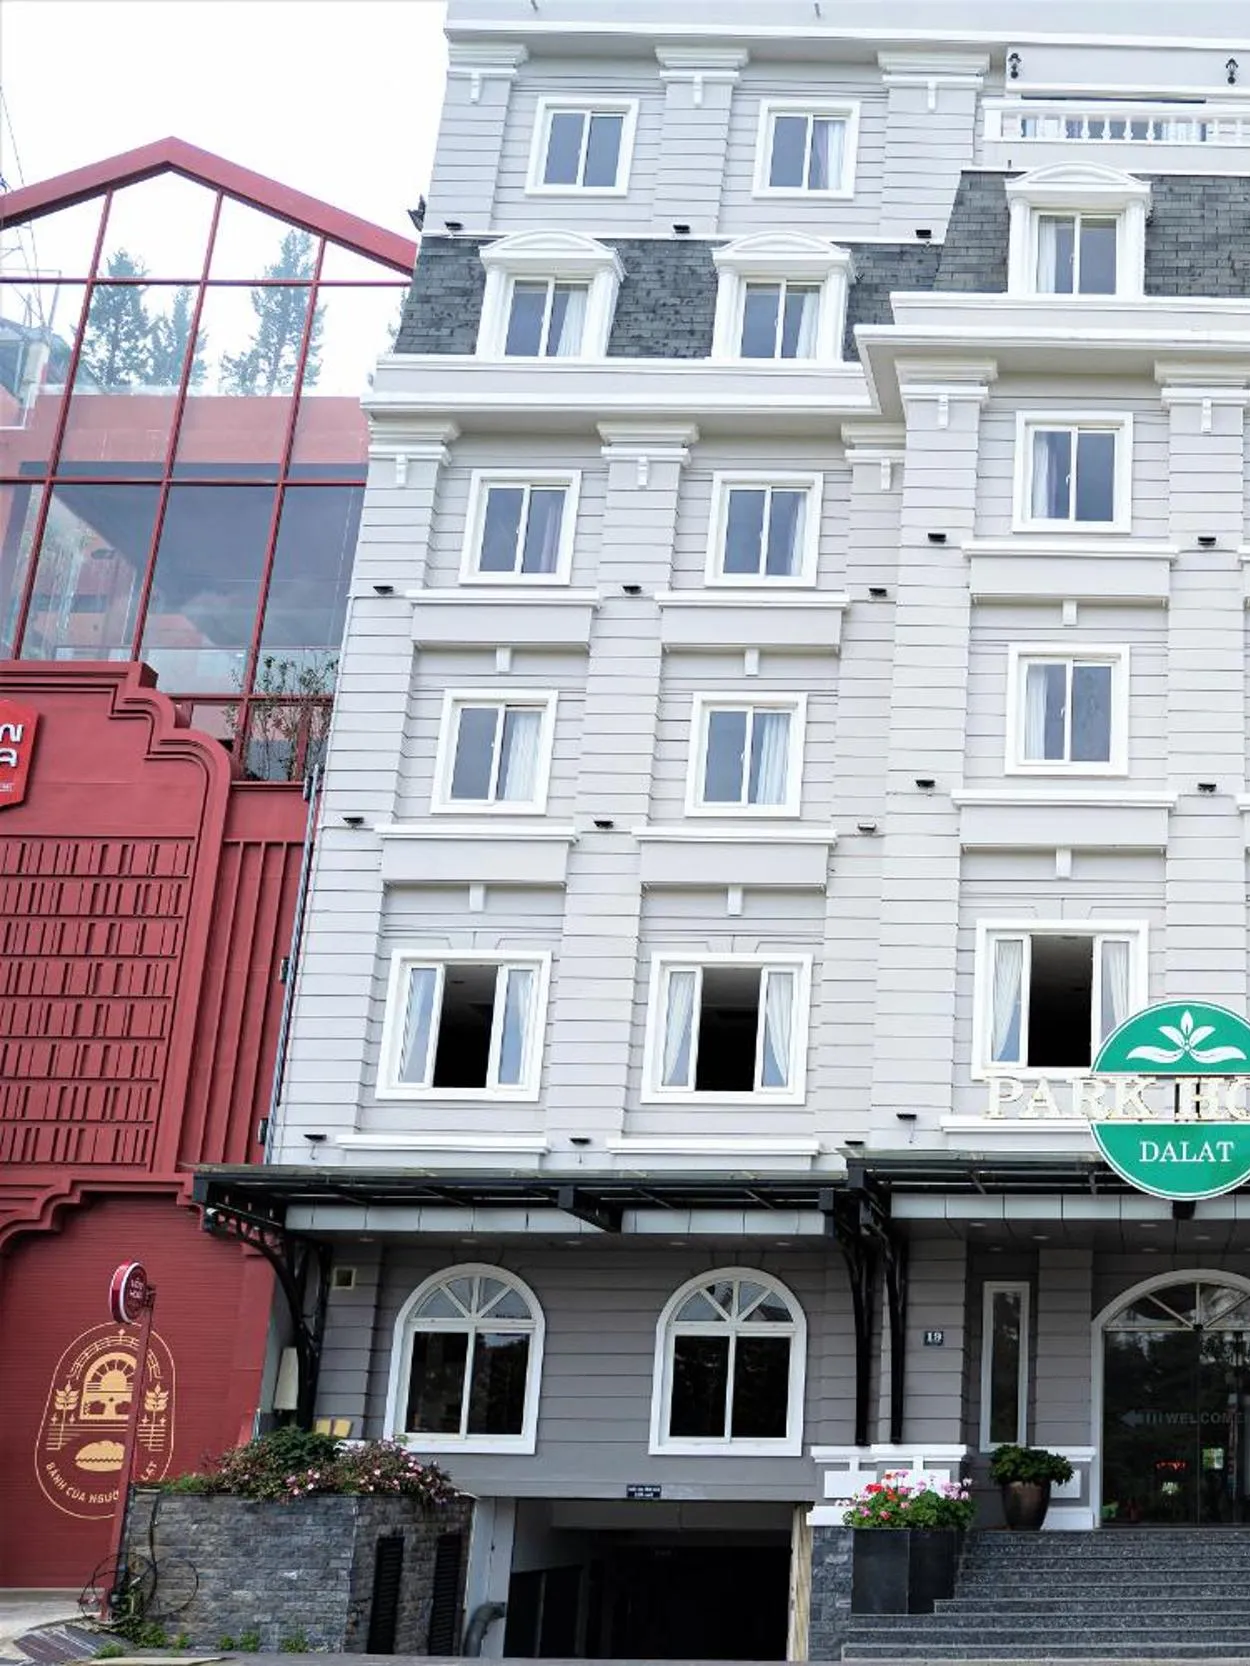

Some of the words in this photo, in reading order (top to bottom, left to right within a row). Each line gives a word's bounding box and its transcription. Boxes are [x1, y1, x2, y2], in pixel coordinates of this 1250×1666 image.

[981, 1075, 1159, 1120] PARK
[1139, 1140, 1235, 1163] DALAT
[1166, 1412, 1244, 1424] WELCOME
